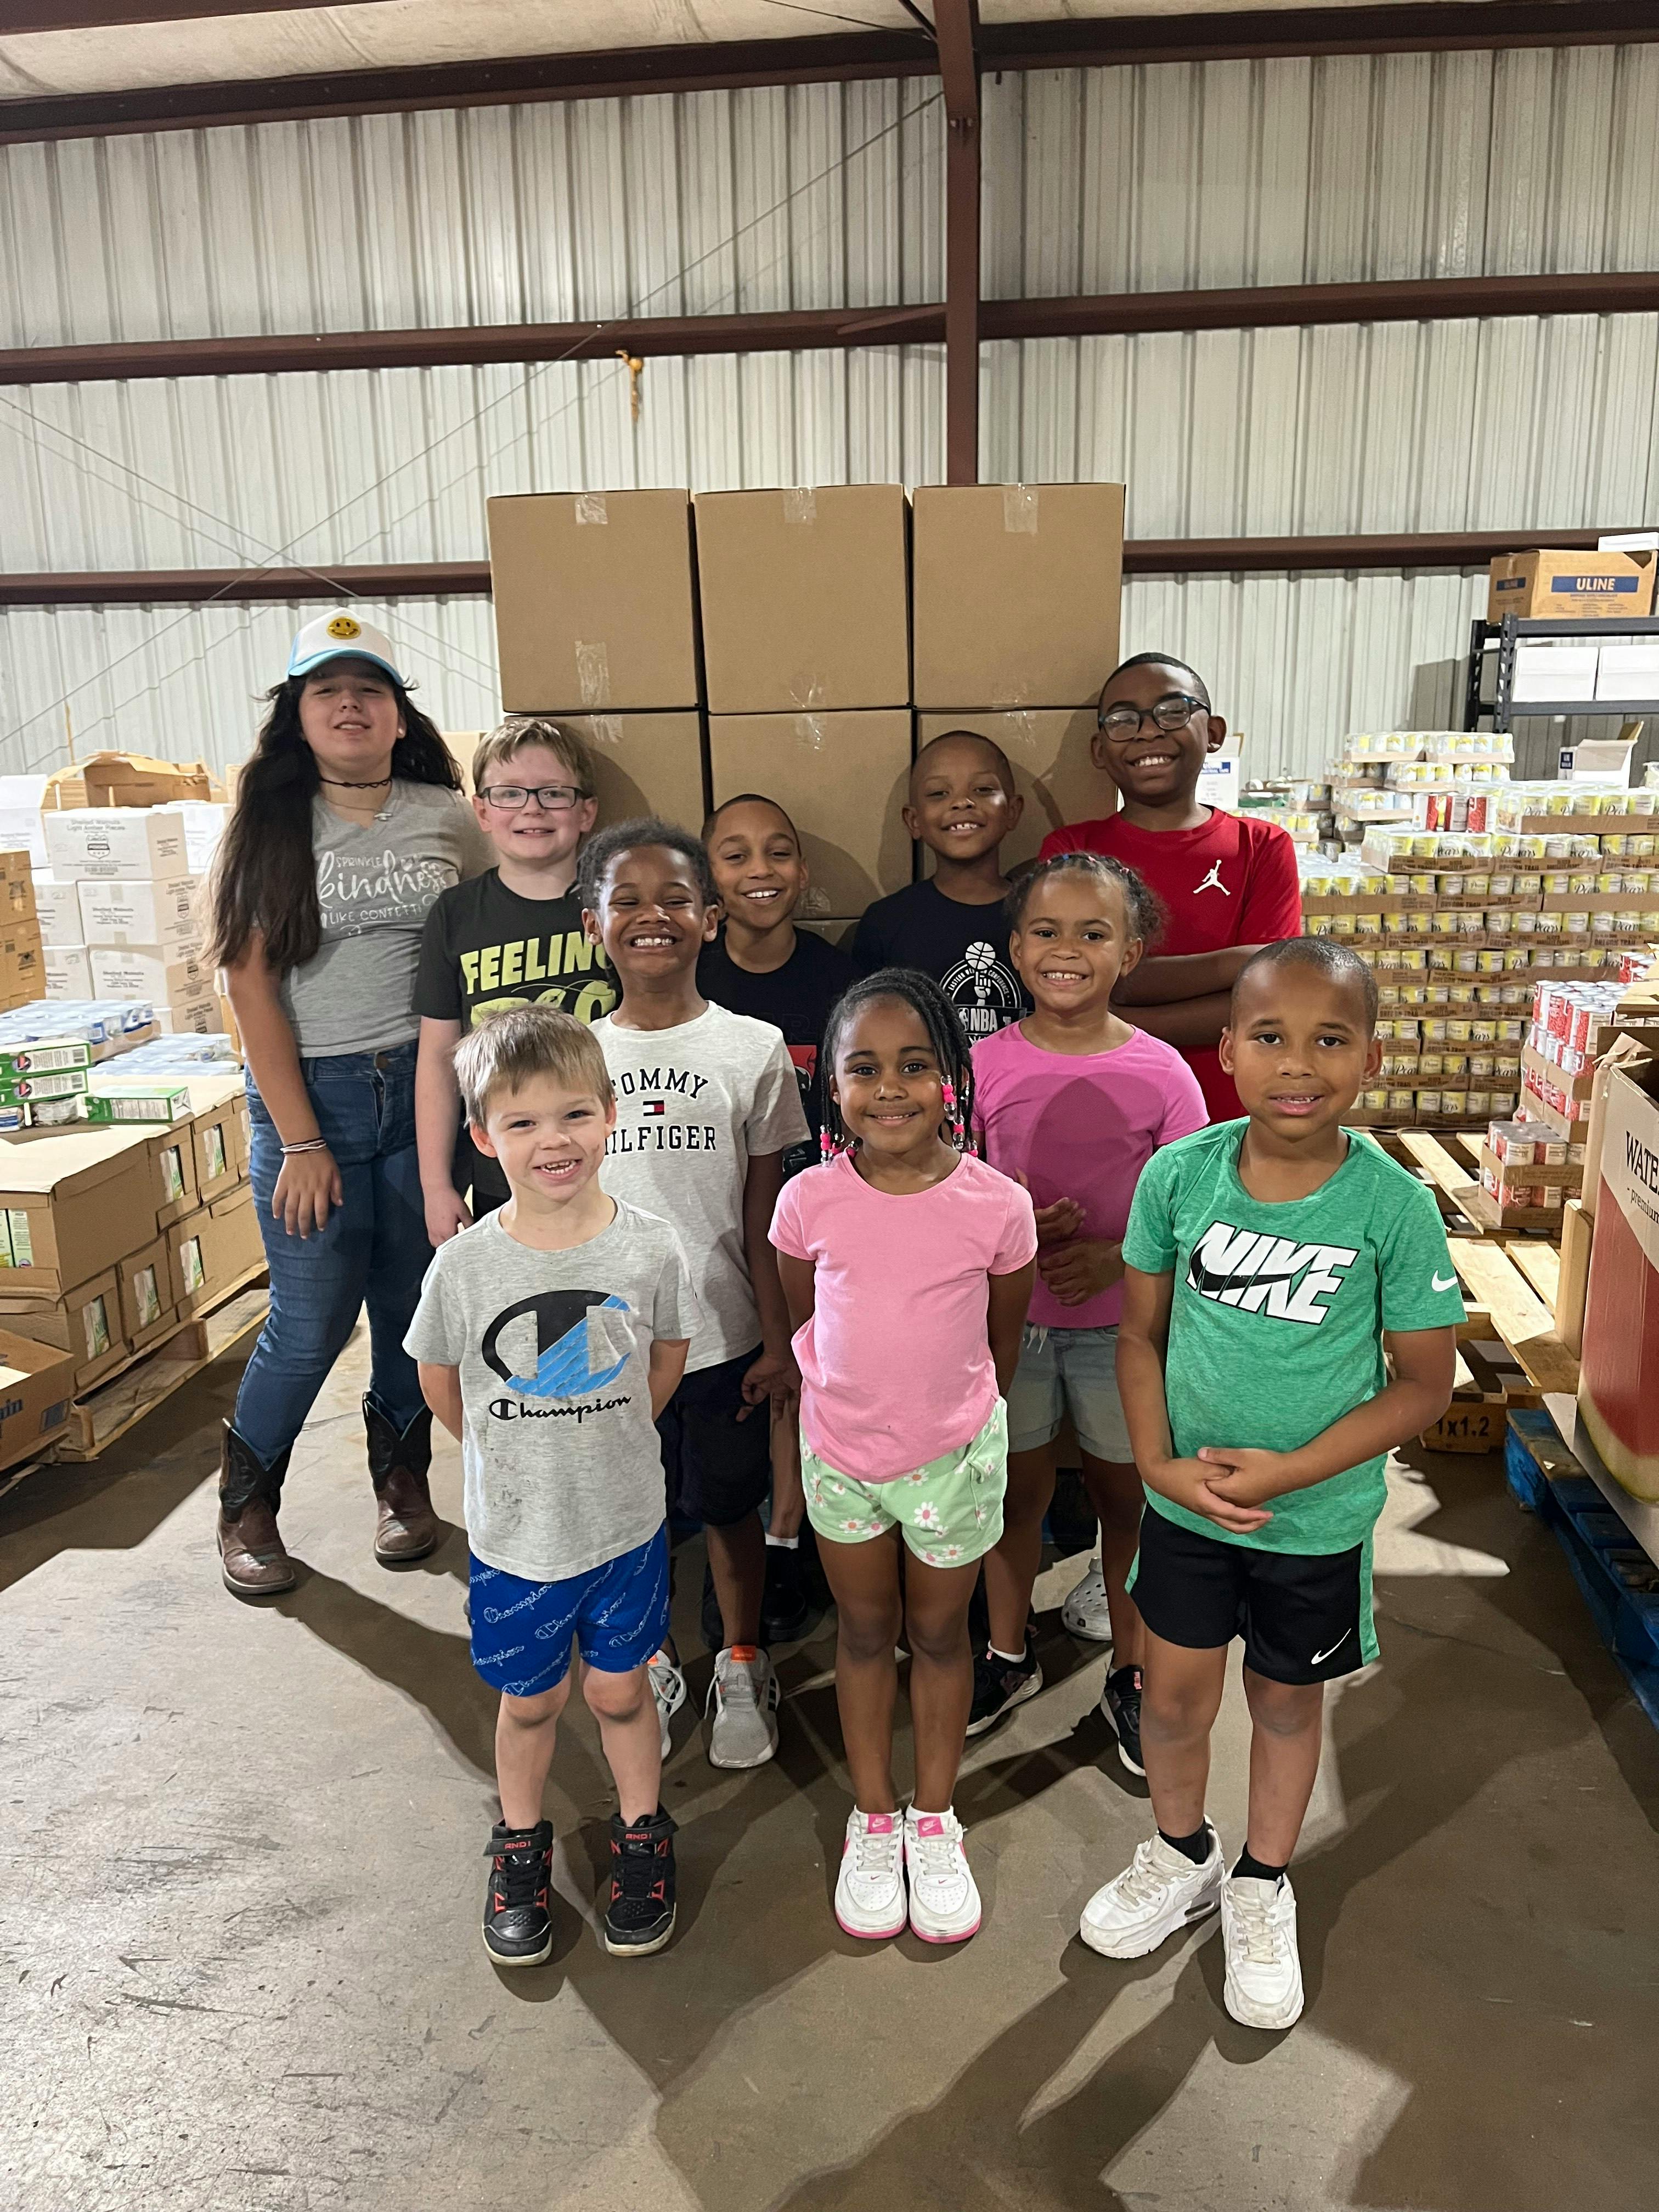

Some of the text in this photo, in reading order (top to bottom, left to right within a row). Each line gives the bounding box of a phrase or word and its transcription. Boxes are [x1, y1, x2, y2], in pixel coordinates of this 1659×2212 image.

[1576, 578, 1616, 591] ULINE
[335, 856, 382, 868] SPRINKLE
[330, 904, 422, 924] LIKE CONFETTI
[970, 1008, 998, 1032] NBA
[1185, 1220, 1361, 1326] NIKE
[489, 1398, 631, 1424] Champion
